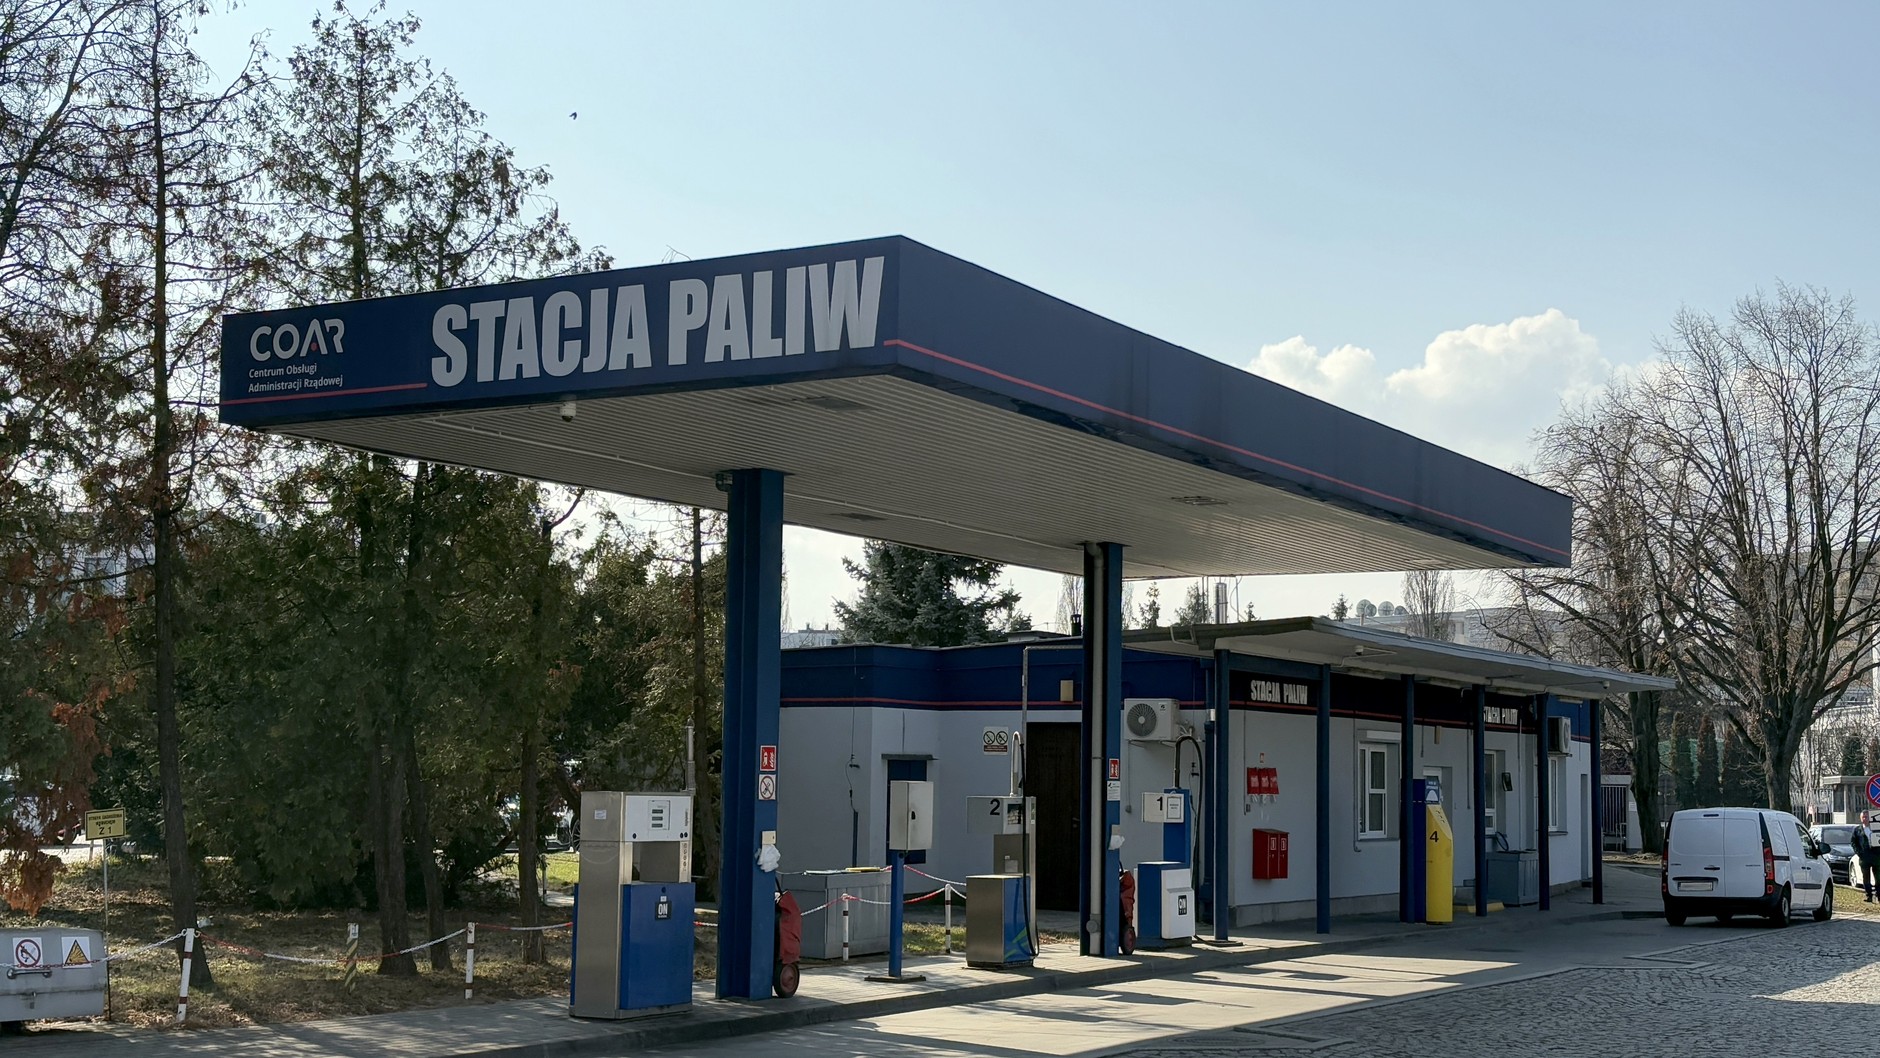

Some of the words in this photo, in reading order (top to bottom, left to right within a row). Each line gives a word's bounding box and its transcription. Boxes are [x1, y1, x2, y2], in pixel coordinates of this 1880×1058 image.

[431, 284, 652, 387] STACJA
[668, 256, 885, 366] PALIW
[250, 318, 345, 362] COAR
[248, 367, 285, 379] Centrum
[286, 363, 317, 375] Obsługi
[248, 379, 302, 393] Administracji
[303, 375, 343, 389] Rządowej
[1250, 680, 1280, 703] STACJA
[1283, 683, 1308, 705] PALIW
[990, 799, 1000, 815] 2
[1157, 796, 1163, 811] 1
[1429, 831, 1439, 843] 4
[658, 903, 668, 915] ON
